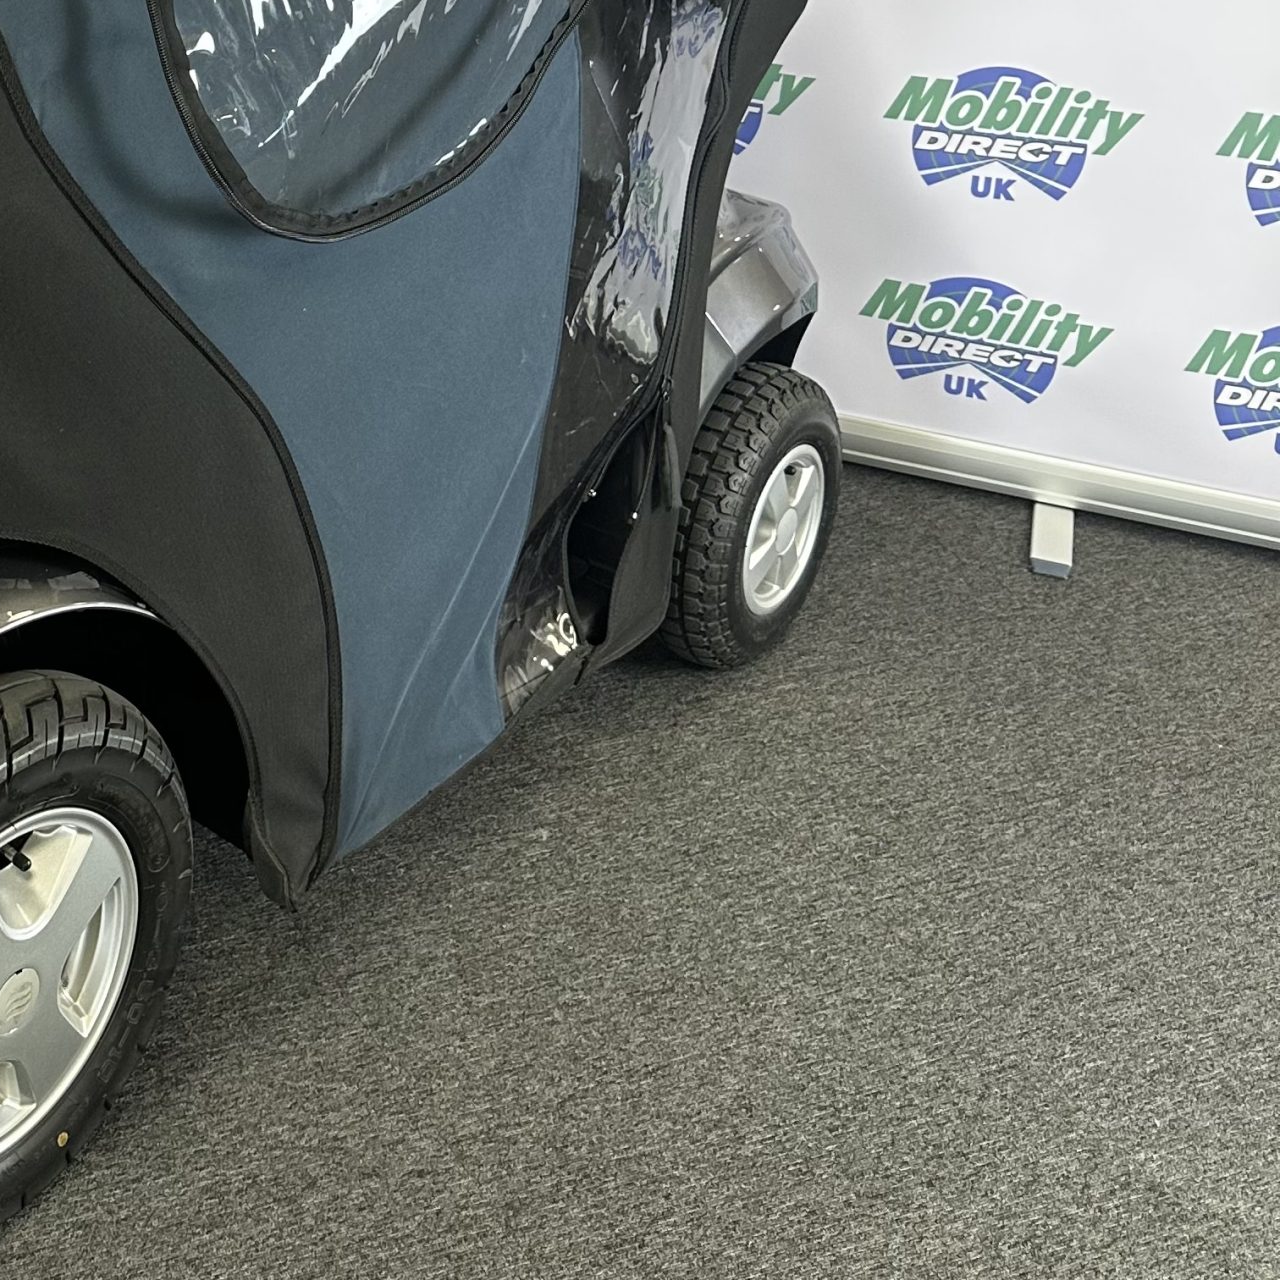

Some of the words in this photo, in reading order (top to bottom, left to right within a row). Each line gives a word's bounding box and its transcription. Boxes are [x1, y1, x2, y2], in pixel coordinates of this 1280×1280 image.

[882, 75, 1145, 156] Mobility
[914, 131, 1087, 166] DIRECT
[971, 176, 1016, 201] UK
[859, 278, 1115, 368] Mobility
[889, 330, 1056, 373] DIRECT
[944, 374, 988, 401] UK
